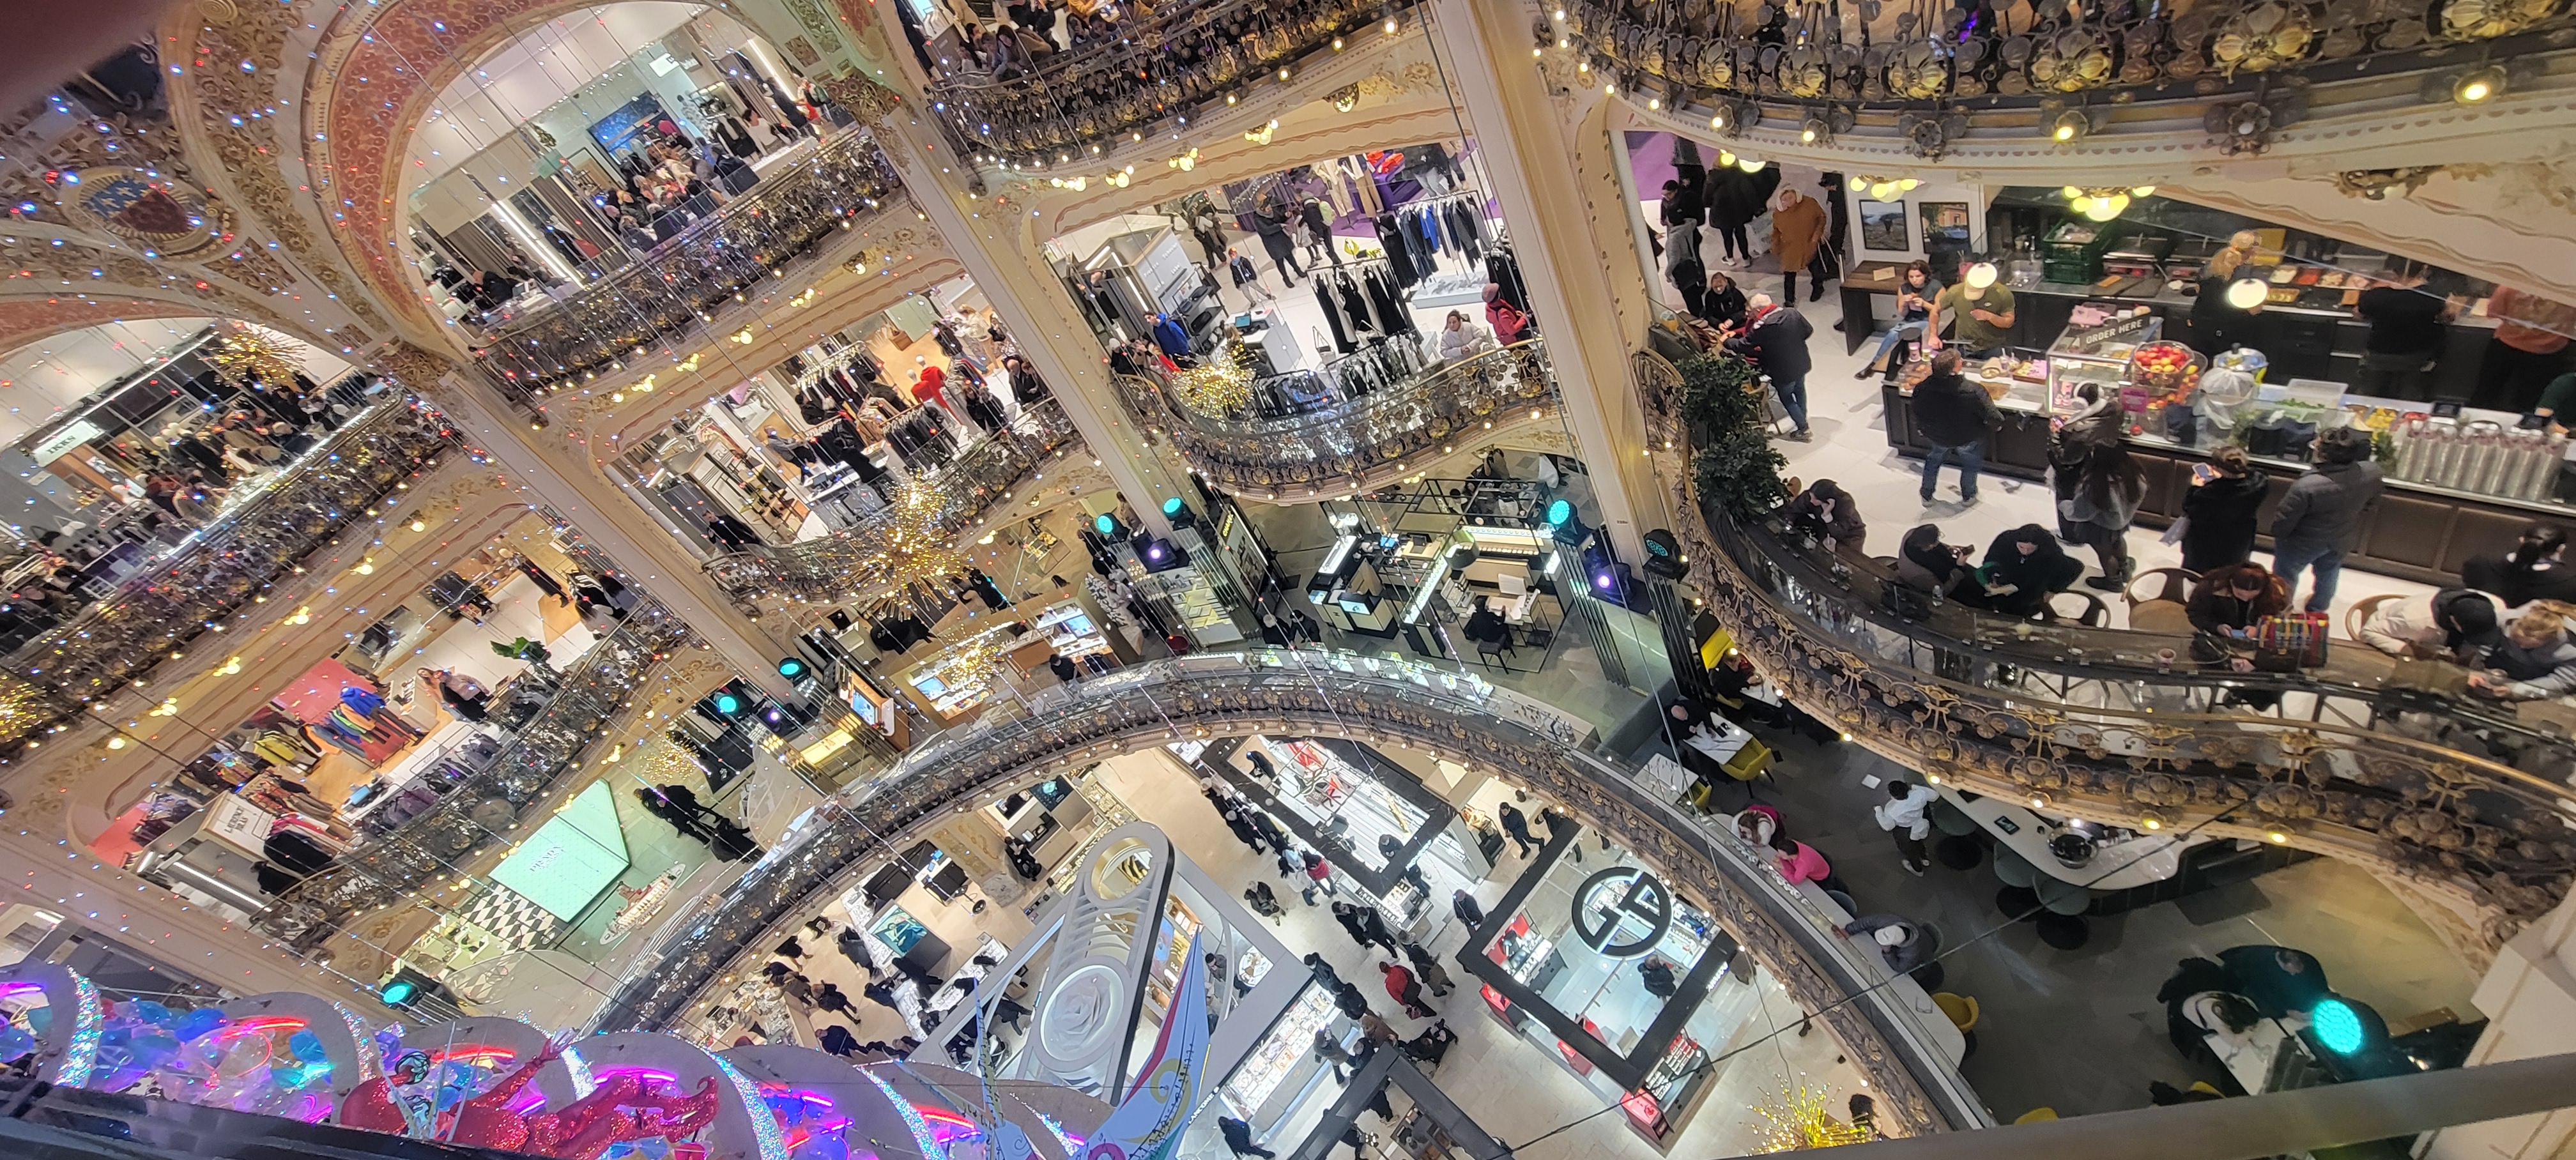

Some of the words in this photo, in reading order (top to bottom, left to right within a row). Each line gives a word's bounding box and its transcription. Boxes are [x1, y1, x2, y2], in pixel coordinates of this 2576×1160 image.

[2086, 328, 2116, 344] ORDER
[2118, 319, 2143, 334] HERE
[47, 435, 76, 454] IKKS
